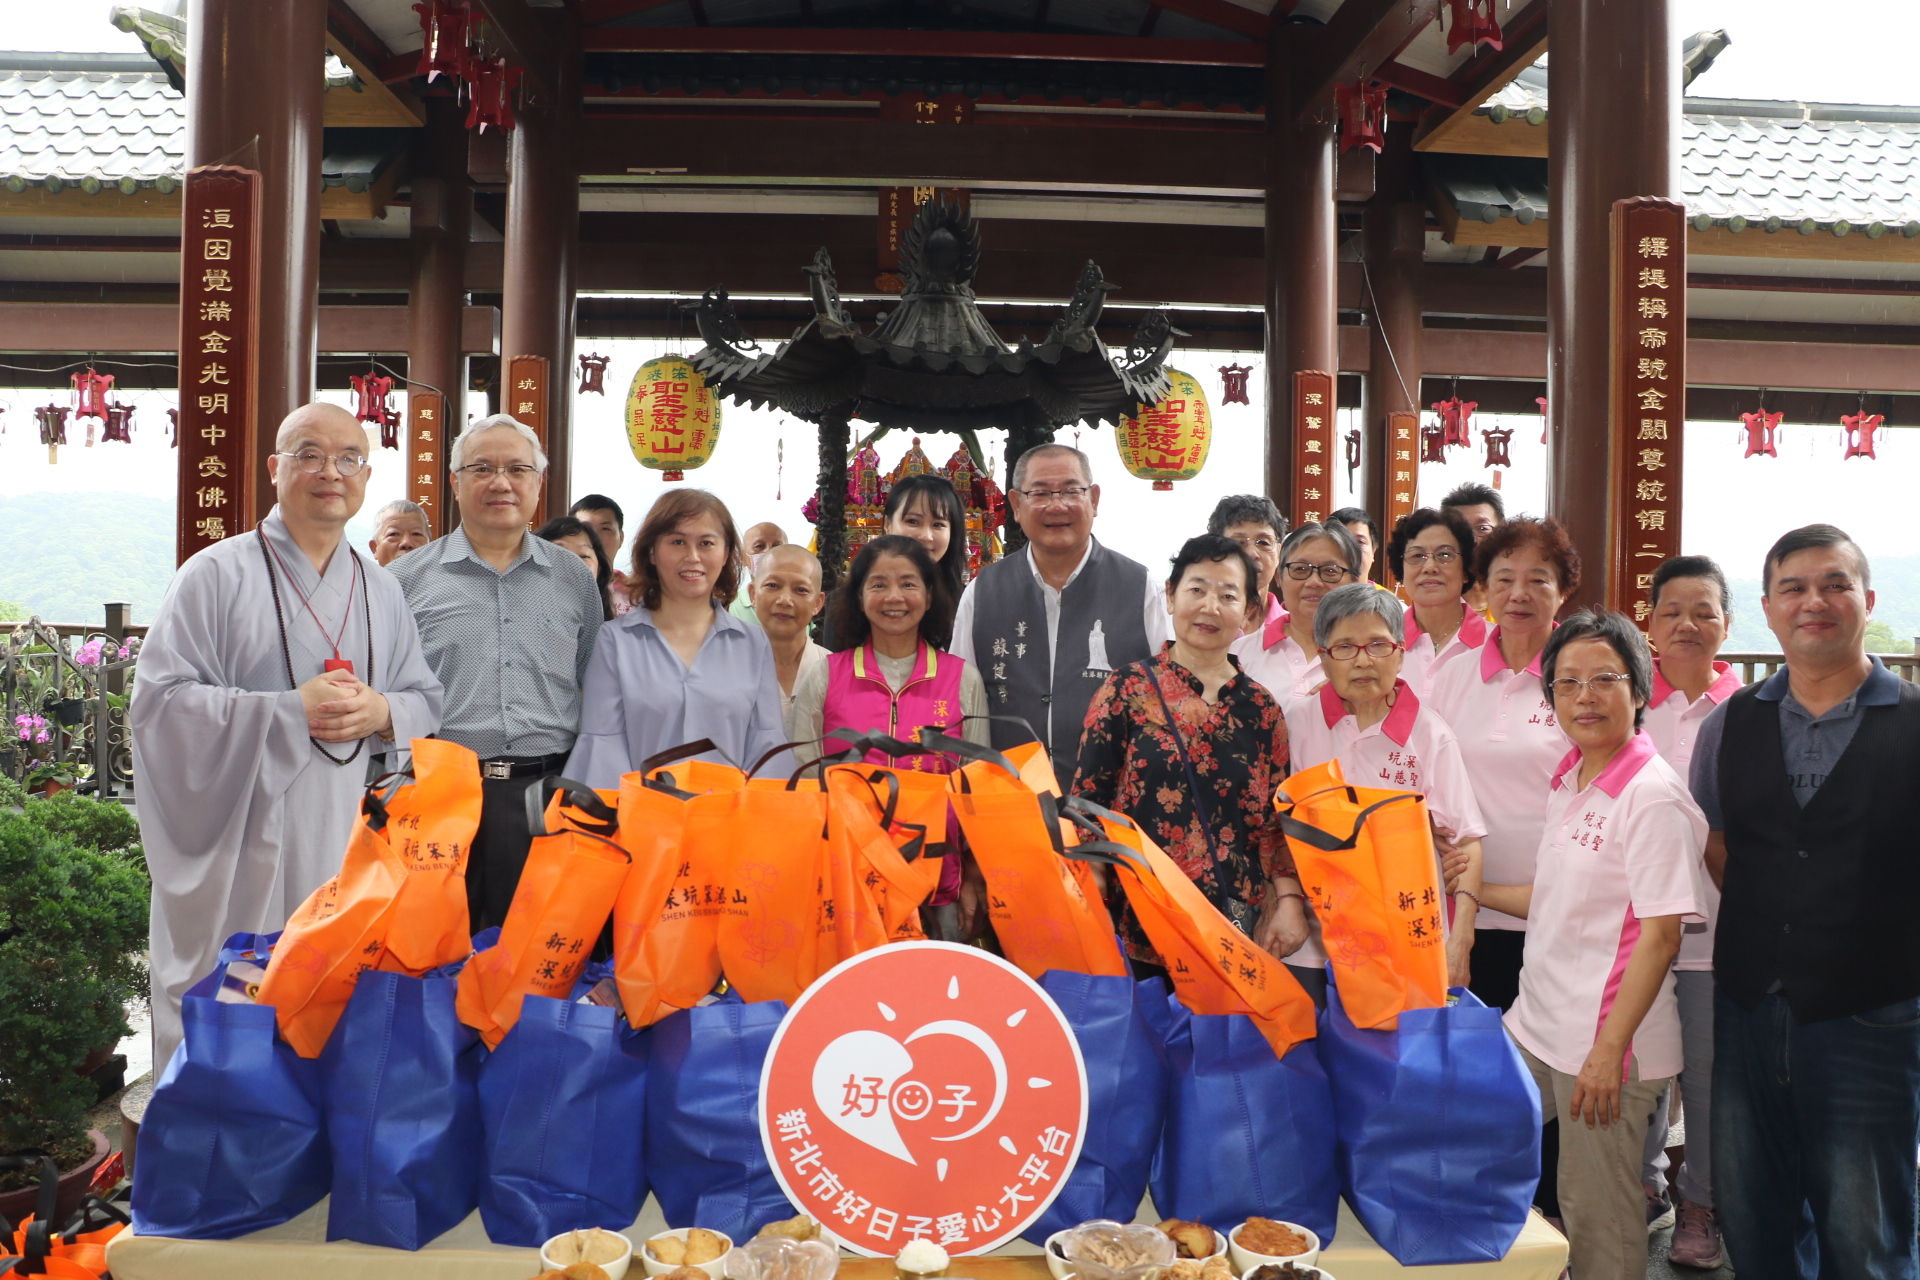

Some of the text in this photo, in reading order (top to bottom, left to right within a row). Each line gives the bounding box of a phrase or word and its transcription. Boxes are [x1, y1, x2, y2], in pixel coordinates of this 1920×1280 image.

[518, 378, 537, 431] 坑藏
[417, 409, 434, 528] 慈恩輝煌天
[1398, 886, 1436, 912] 新北
[546, 932, 584, 953] 新北
[776, 1108, 1071, 1247] 新北市好日子愛心大平台
